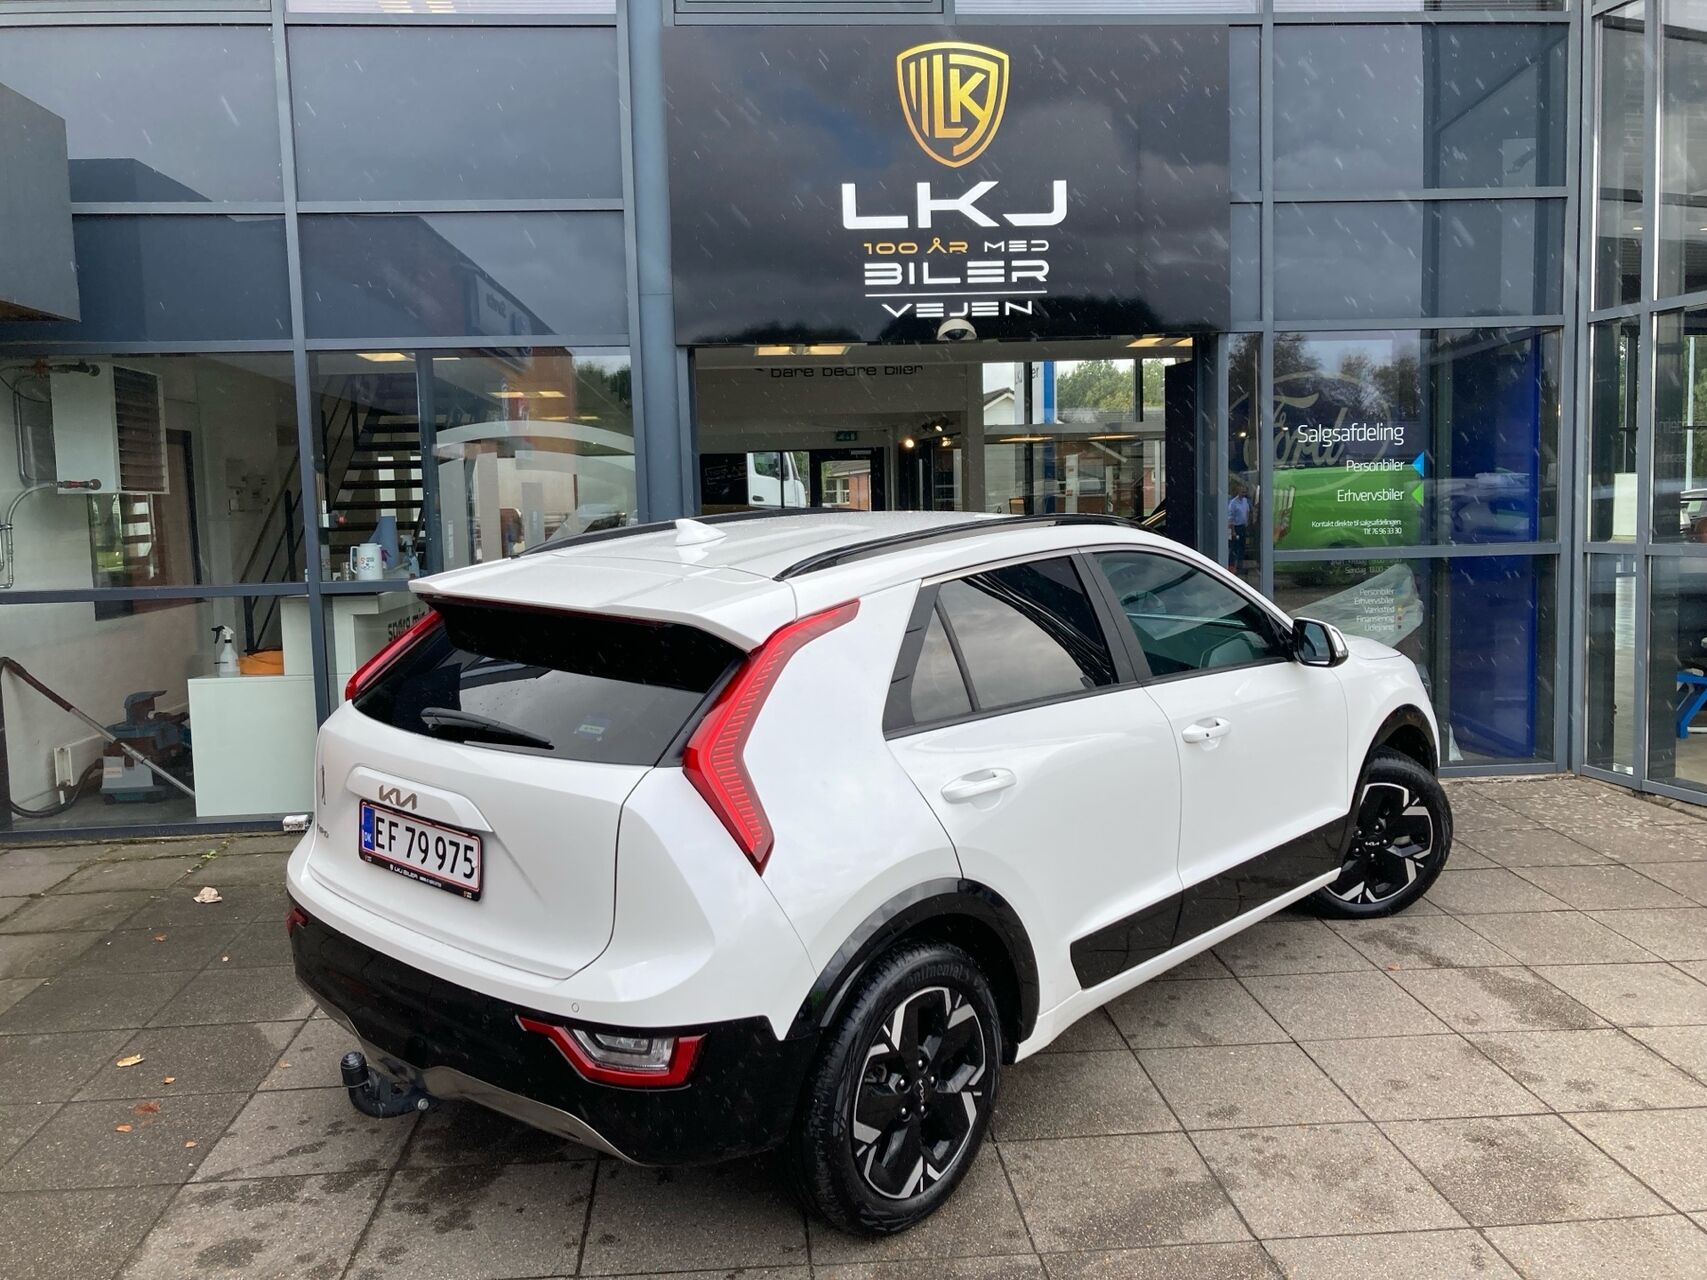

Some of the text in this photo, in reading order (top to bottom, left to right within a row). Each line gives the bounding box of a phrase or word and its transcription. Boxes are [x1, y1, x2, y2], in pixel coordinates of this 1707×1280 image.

[841, 179, 1068, 230] LKJ
[863, 237, 1050, 255] 100 ÅR MED
[863, 259, 1050, 286] BILER
[881, 300, 1033, 319] VEJEN
[1297, 422, 1405, 447] Salgsafdeling
[1346, 458, 1405, 472] Personbiler
[1337, 488, 1405, 502] Erhvervsbiler
[378, 784, 418, 811] KIA
[375, 816, 399, 852] EF
